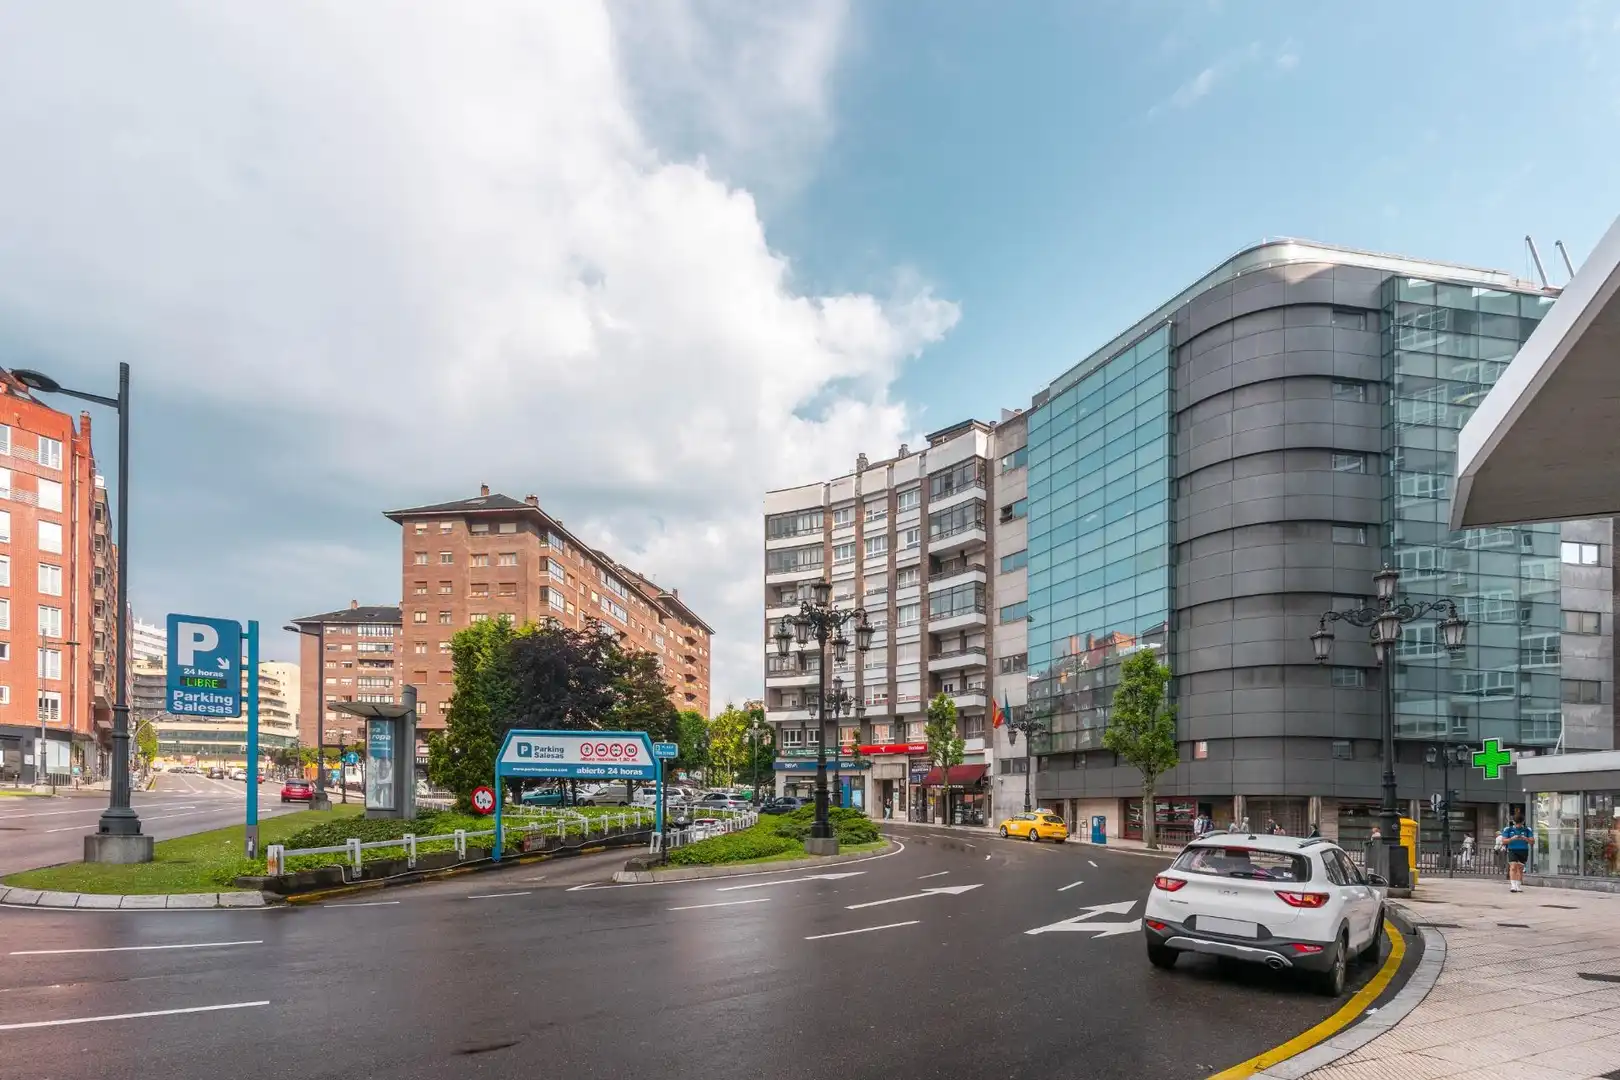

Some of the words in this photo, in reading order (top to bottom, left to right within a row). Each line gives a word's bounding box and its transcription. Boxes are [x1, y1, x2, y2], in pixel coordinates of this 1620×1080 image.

[177, 621, 219, 666] P
[183, 667, 196, 676] 24
[198, 669, 224, 678] horas
[186, 677, 218, 689] LIBRE
[173, 690, 233, 706] Parking
[173, 701, 233, 714] Salesas
[533, 745, 565, 754] Parking
[533, 752, 565, 760] Salesas
[576, 767, 605, 775] abierto
[620, 768, 643, 776] horas
